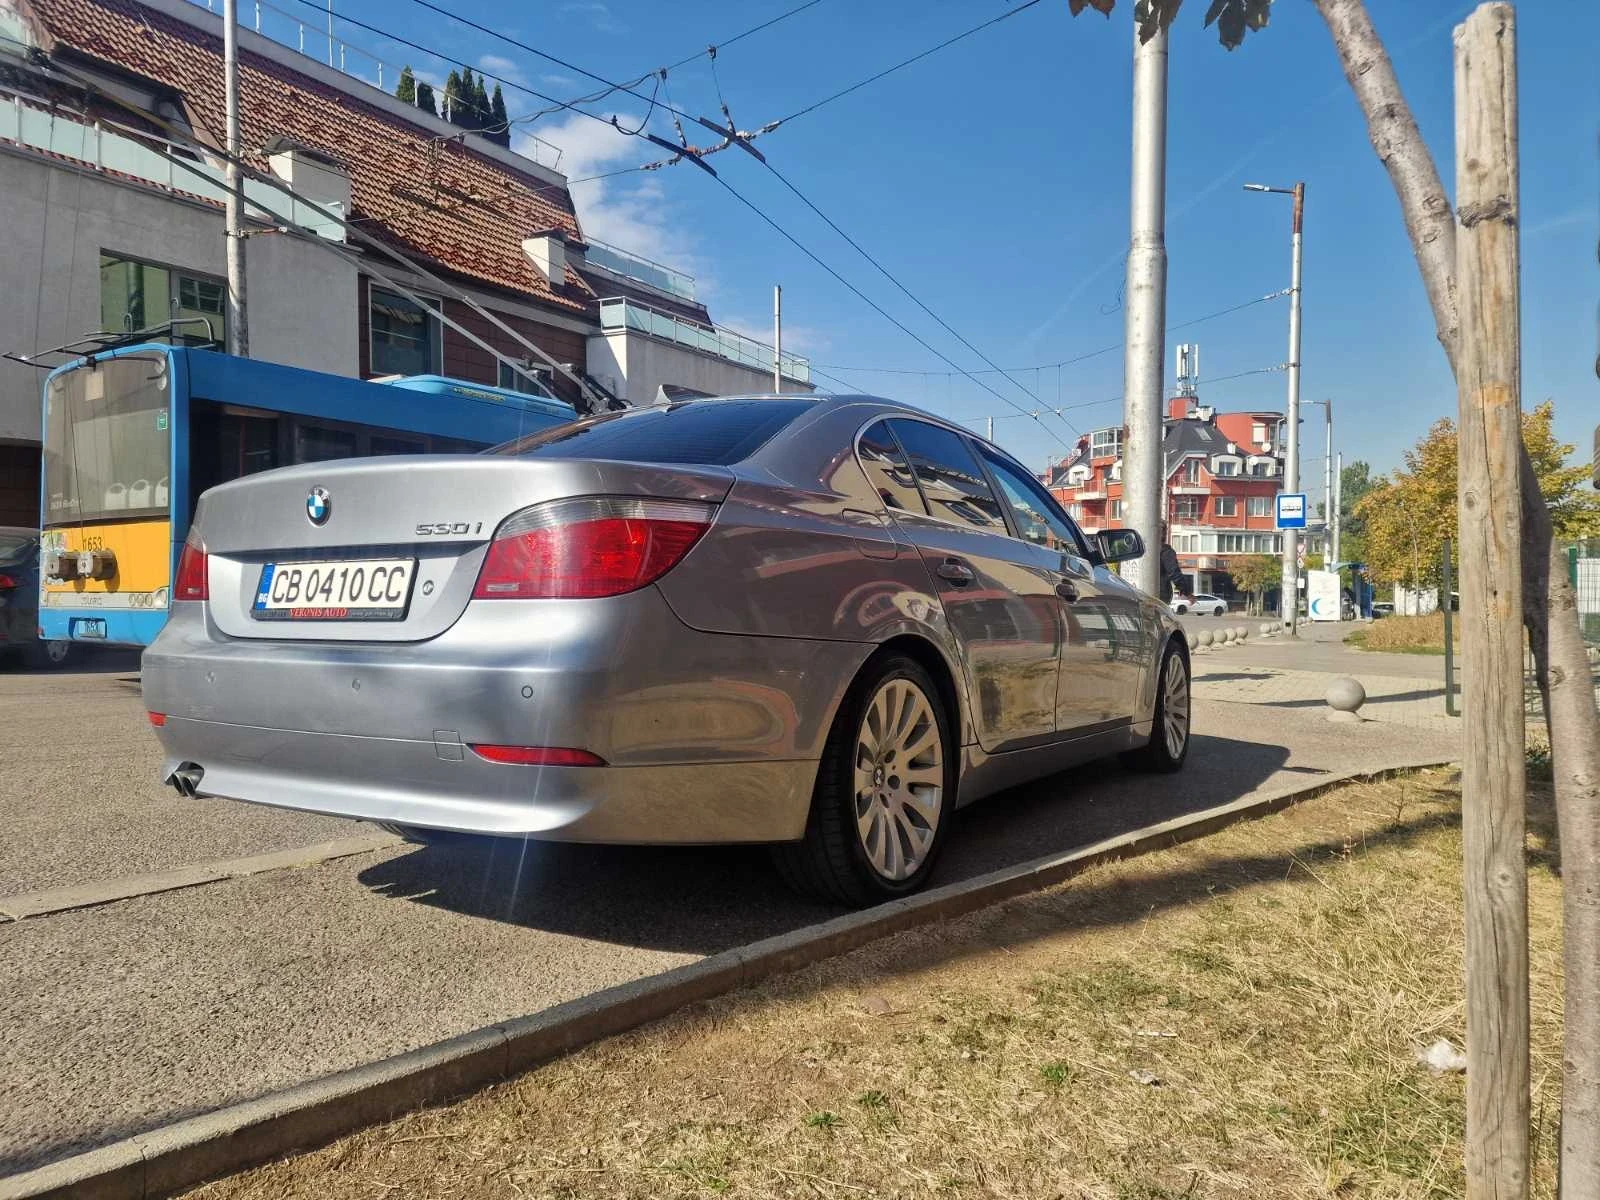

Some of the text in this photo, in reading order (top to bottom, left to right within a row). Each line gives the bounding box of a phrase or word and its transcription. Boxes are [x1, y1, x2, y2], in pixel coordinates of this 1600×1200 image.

[272, 566, 405, 603] CB 0410 CC
[324, 608, 347, 617] AUTO
